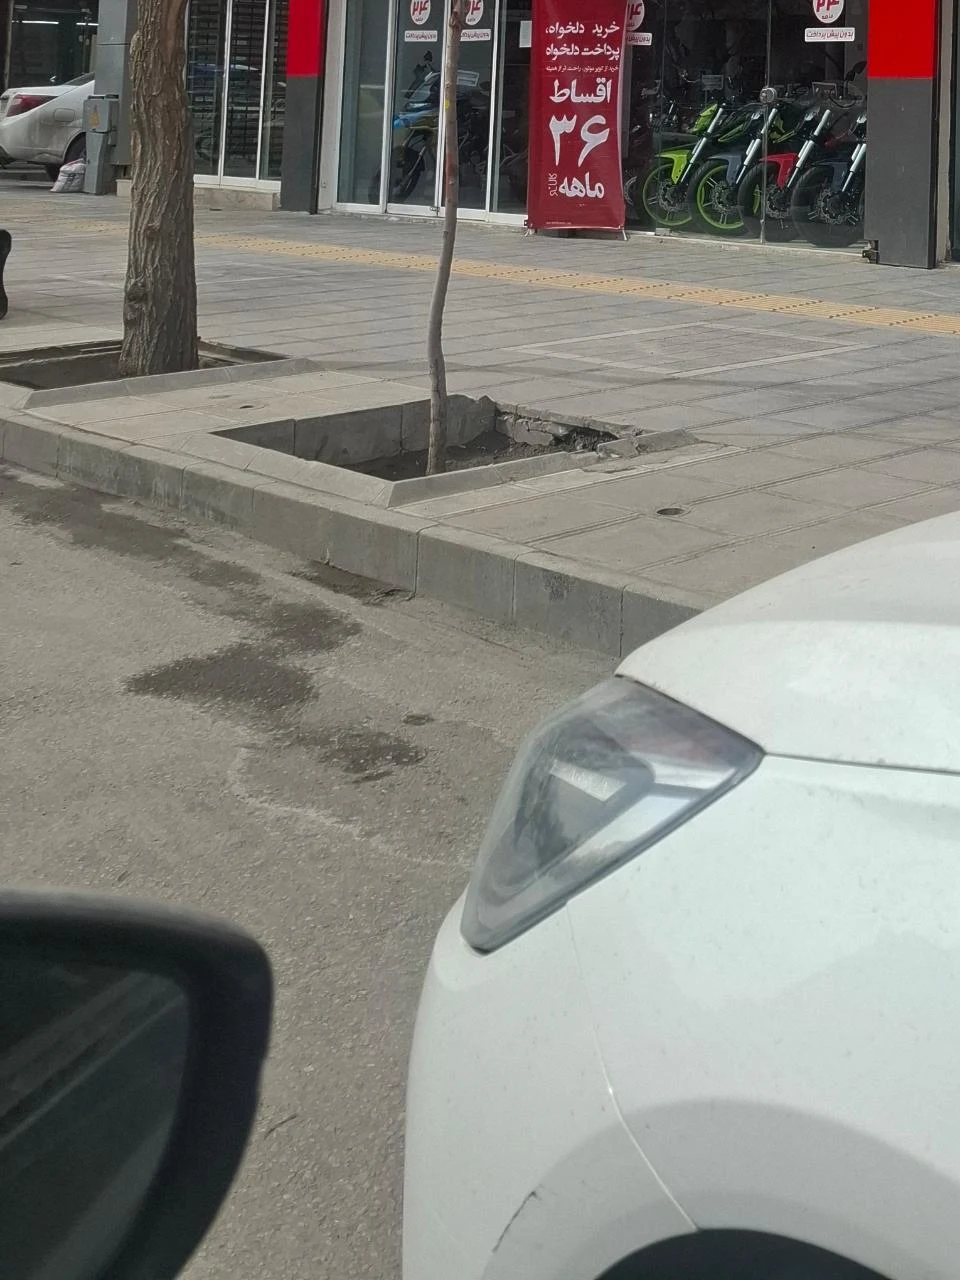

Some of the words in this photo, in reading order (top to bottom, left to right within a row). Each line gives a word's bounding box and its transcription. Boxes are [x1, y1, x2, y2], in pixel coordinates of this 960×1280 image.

[545, 21, 585, 39] دلخواه،
[592, 21, 620, 39] خرید
[546, 43, 580, 61] دلخواه
[581, 43, 620, 61] پرداخت
[549, 77, 612, 103] اقساط
[549, 114, 610, 168] ۳۶
[558, 172, 605, 198] ماهه
